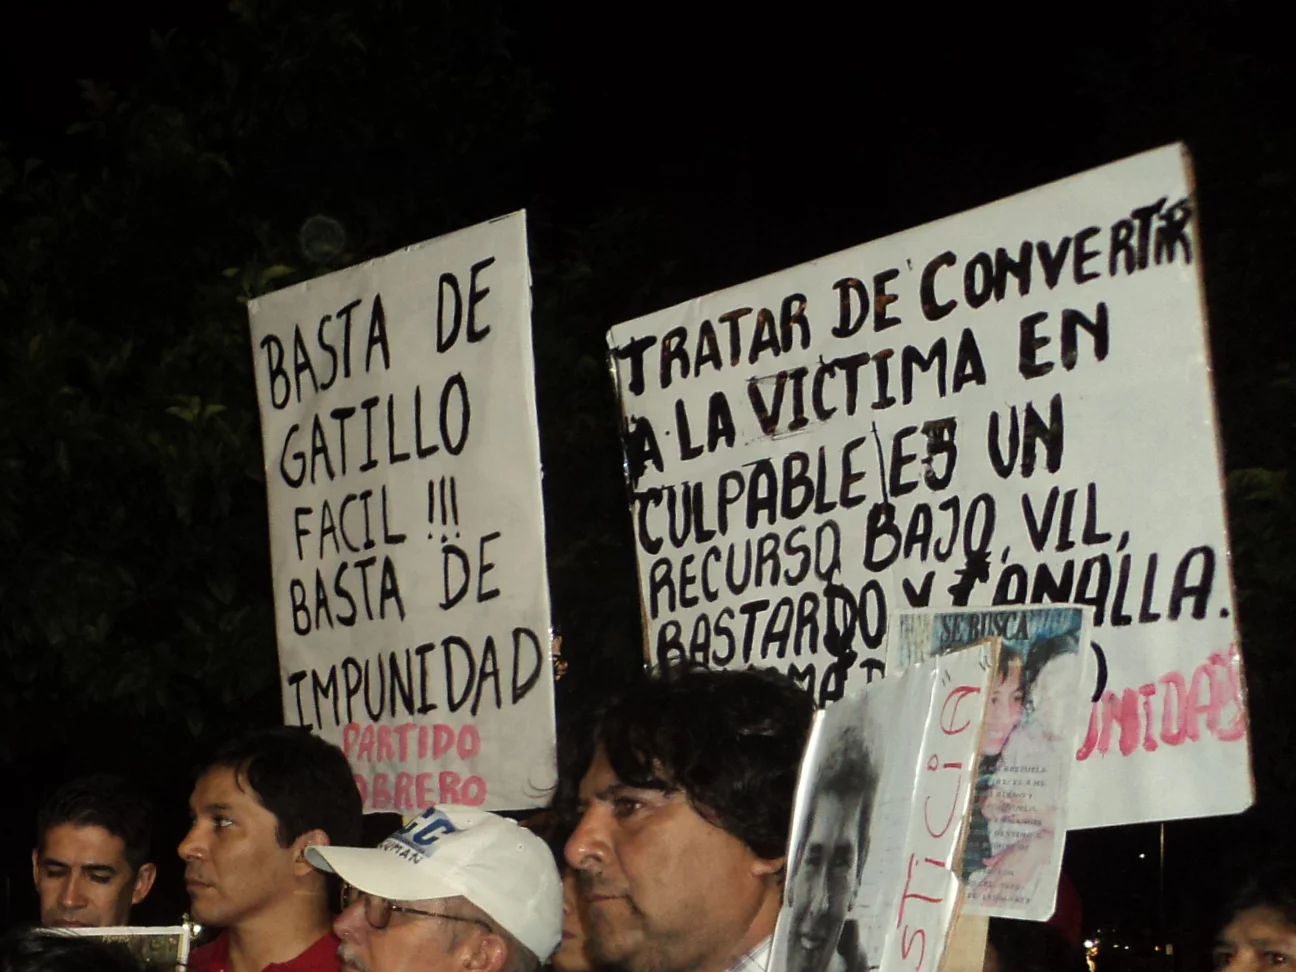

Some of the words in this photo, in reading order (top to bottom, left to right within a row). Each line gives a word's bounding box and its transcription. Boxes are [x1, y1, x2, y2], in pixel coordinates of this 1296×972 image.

[260, 293, 391, 410] BASTA
[436, 256, 496, 354] DE
[614, 292, 811, 396] TRATAR
[831, 268, 902, 340] DE
[279, 371, 471, 489] GATILLO
[625, 415, 664, 487] A
[676, 388, 737, 462] LA
[746, 327, 987, 439] VICTIMA
[1018, 301, 1111, 381] EN
[294, 483, 407, 562] FACIL
[426, 475, 461, 544] !!!
[633, 434, 867, 555] CULPABLE
[988, 393, 1066, 479] UN
[289, 554, 406, 638] BASTA
[439, 530, 503, 611] DE
[647, 516, 841, 621] RECURSO
[287, 626, 546, 734] IMPUNIDAD
[342, 720, 481, 763] PARTIDO
